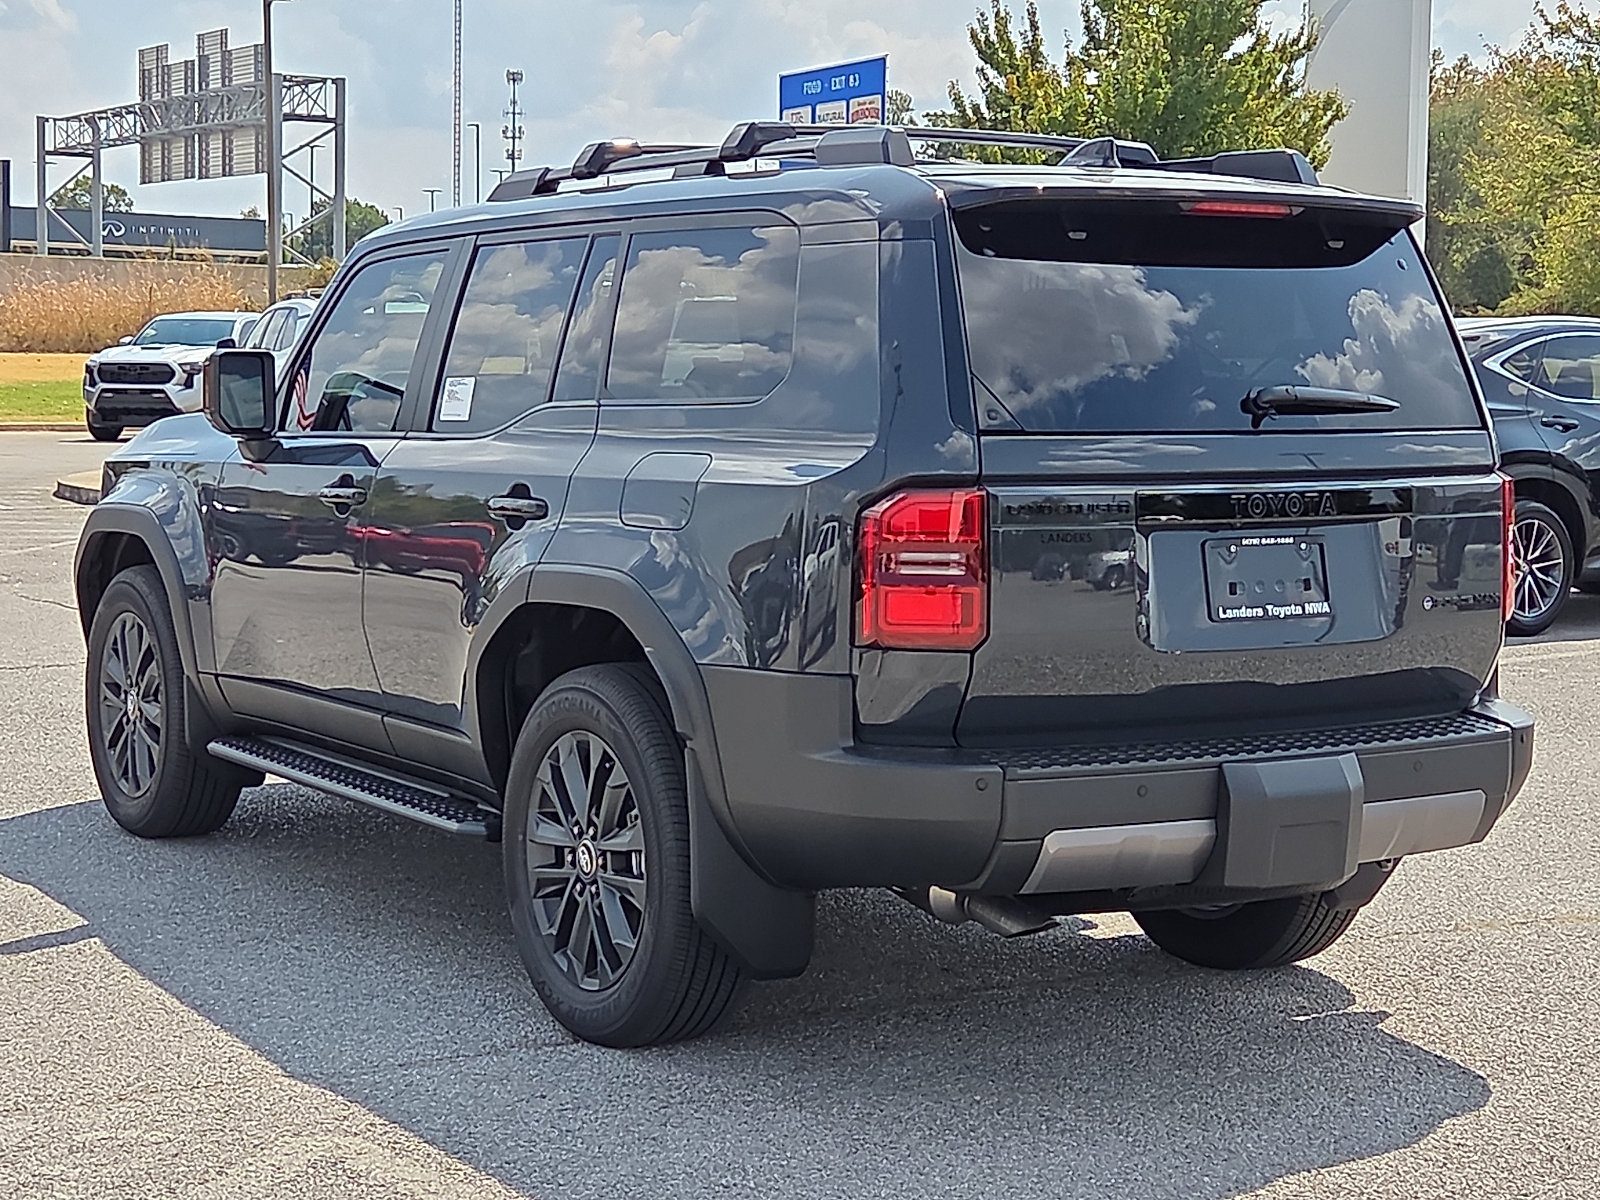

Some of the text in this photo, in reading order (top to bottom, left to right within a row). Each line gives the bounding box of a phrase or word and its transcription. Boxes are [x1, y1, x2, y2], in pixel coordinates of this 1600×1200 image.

[803, 80, 822, 95] FOOD
[831, 75, 846, 91] EXIT
[130, 225, 200, 237] INFINITI
[1230, 492, 1337, 518] TOYOTA
[1040, 532, 1093, 544] LANDERS
[1218, 601, 1331, 619] Landers Toyota NWA
